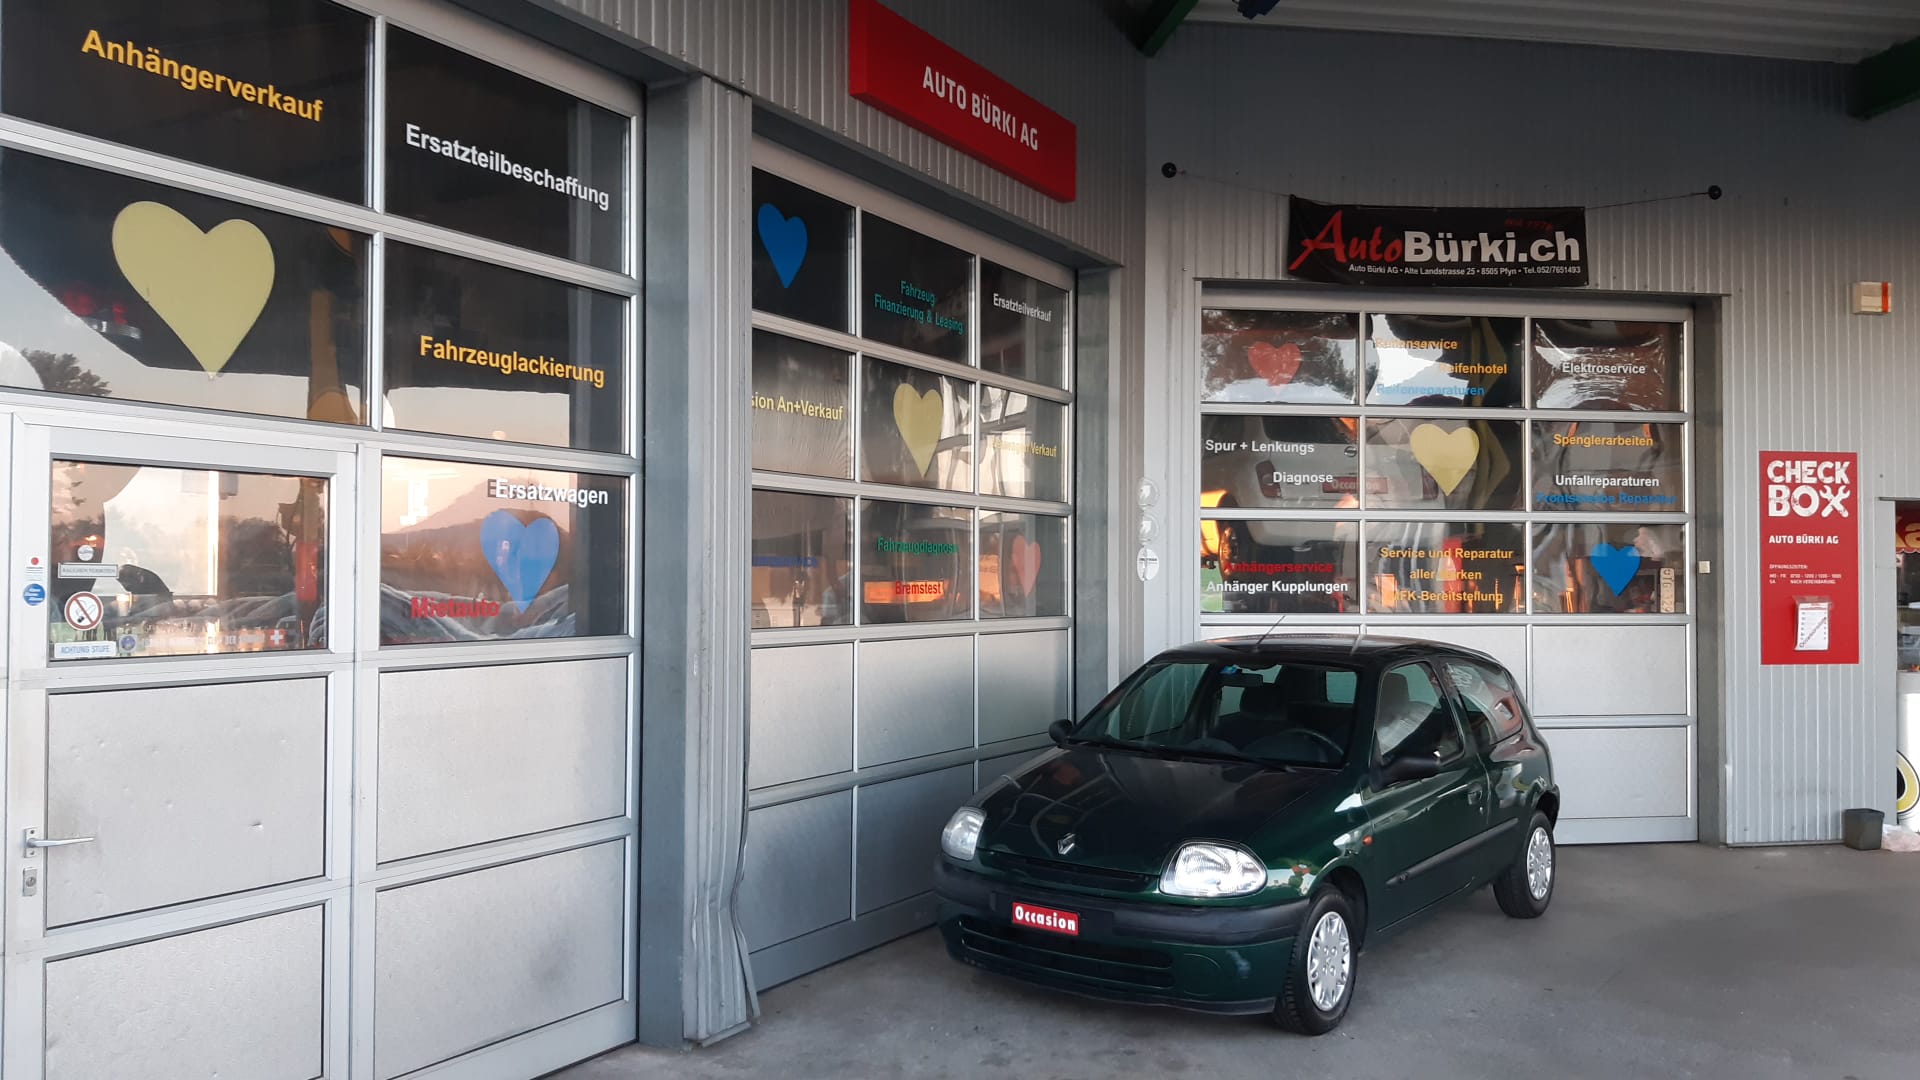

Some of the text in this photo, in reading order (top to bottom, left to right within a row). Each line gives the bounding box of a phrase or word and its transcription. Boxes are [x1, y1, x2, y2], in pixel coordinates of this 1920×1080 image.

[81, 29, 324, 122] Anhängerverkauf
[922, 65, 1038, 151] AUTO BÜRKI AG
[405, 122, 610, 211] Ersatzteilbeschaffung
[1348, 263, 1367, 273] Auto
[1367, 265, 1386, 274] Bürki
[1387, 266, 1399, 274] AG
[1404, 266, 1418, 275] Alte
[1420, 266, 1465, 276] Landstrasse
[1466, 267, 1476, 275] 25
[900, 280, 935, 306] Fahrzeug
[874, 293, 964, 335] Finanzierung & Leasing
[993, 293, 1052, 322] Ersatzteilverkauf
[419, 334, 605, 389] Fahrzeuglackierung
[1561, 362, 1646, 375] Elektroservice
[1205, 440, 1315, 455] Spur + Lenkungs
[1553, 433, 1654, 449] Spenglerarbeiten
[1273, 471, 1334, 486] Diagnose
[1555, 474, 1660, 489] Unfallreparaturen
[1766, 460, 1851, 484] CHECK
[494, 478, 608, 508] Ersatzwagen
[1768, 484, 1851, 518] BOX
[1769, 533, 1839, 544] AUTO BÜRKI AG
[1380, 547, 1515, 561] Service und Reparatur
[1409, 568, 1436, 580] aller
[895, 581, 942, 595] Bremstest
[1206, 580, 1349, 595] Anhänger Kupplungen
[411, 596, 500, 619] Mietauto
[1015, 905, 1076, 931] Occasion
